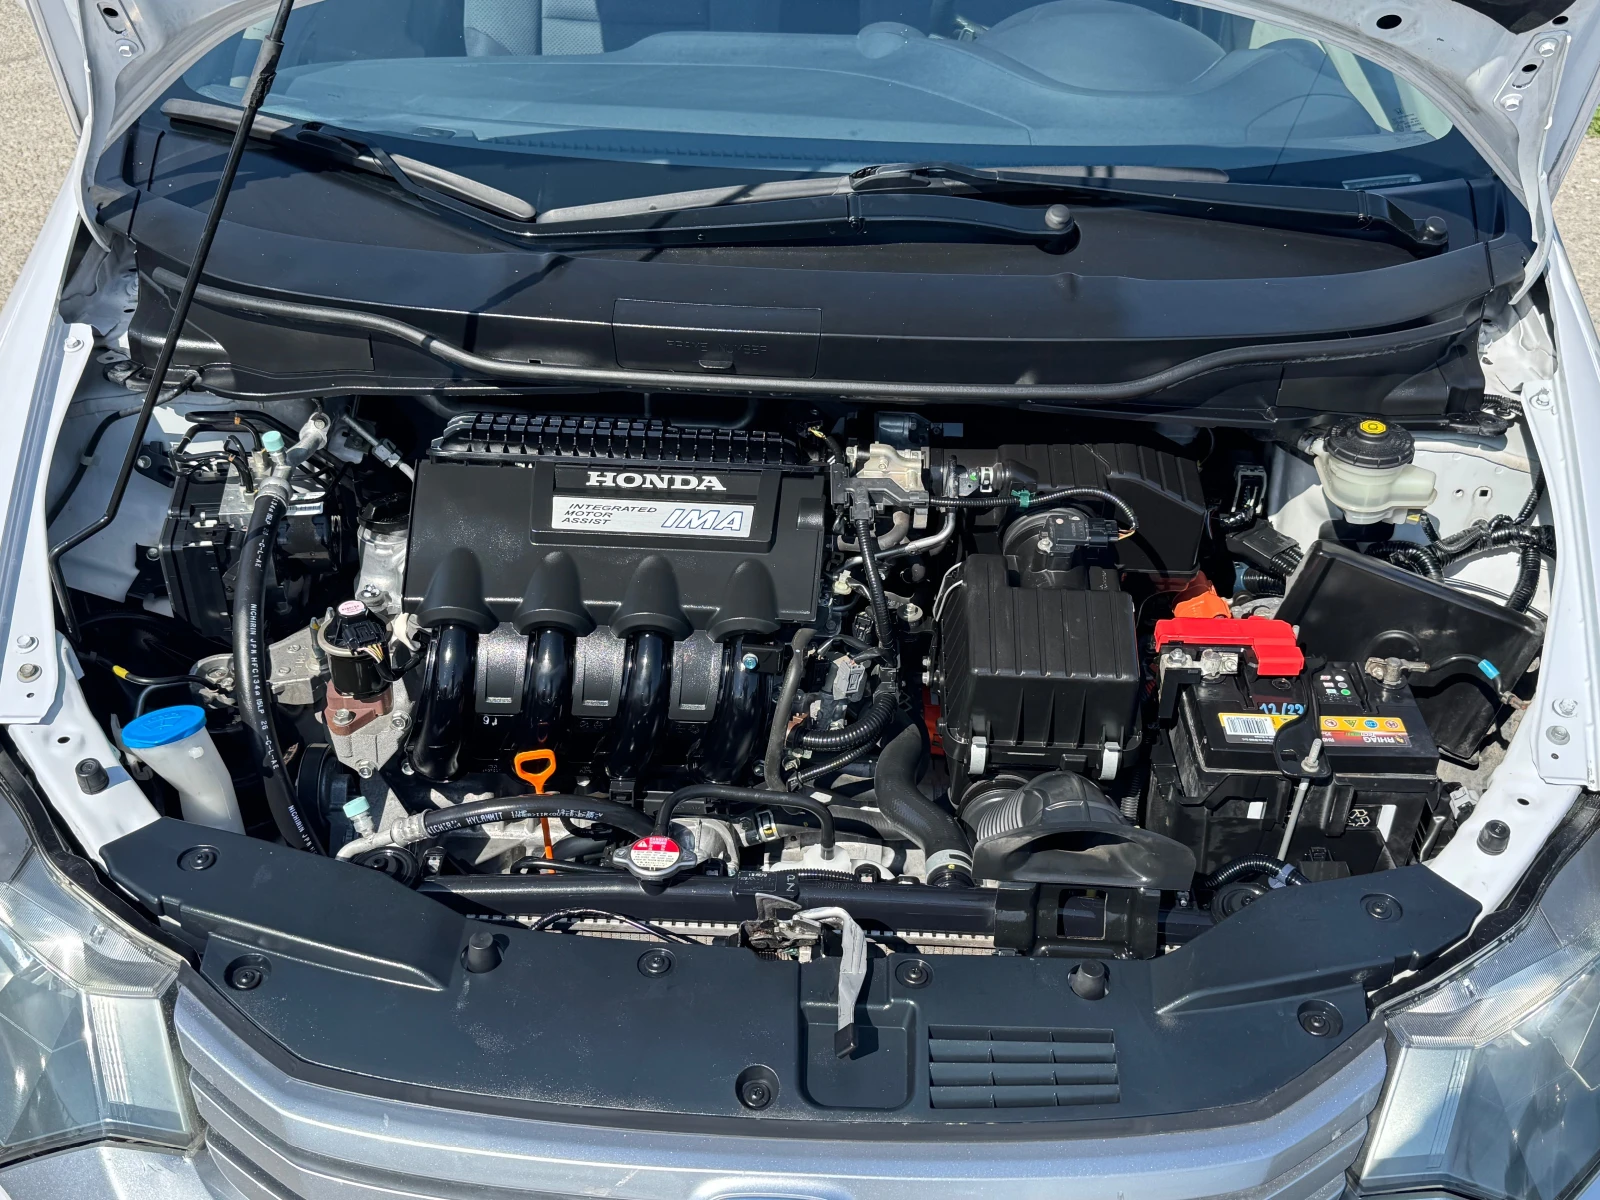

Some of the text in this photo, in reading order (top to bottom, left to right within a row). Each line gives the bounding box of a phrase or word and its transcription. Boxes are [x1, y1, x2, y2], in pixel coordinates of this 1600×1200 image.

[586, 471, 727, 491] HONDA
[568, 503, 657, 513] INTEGRATED
[564, 510, 613, 518] MOTOR
[561, 517, 611, 525] ASSIST
[661, 508, 744, 531] IMA
[249, 603, 258, 635] NICHIRIN
[1363, 735, 1396, 743] RHIAG
